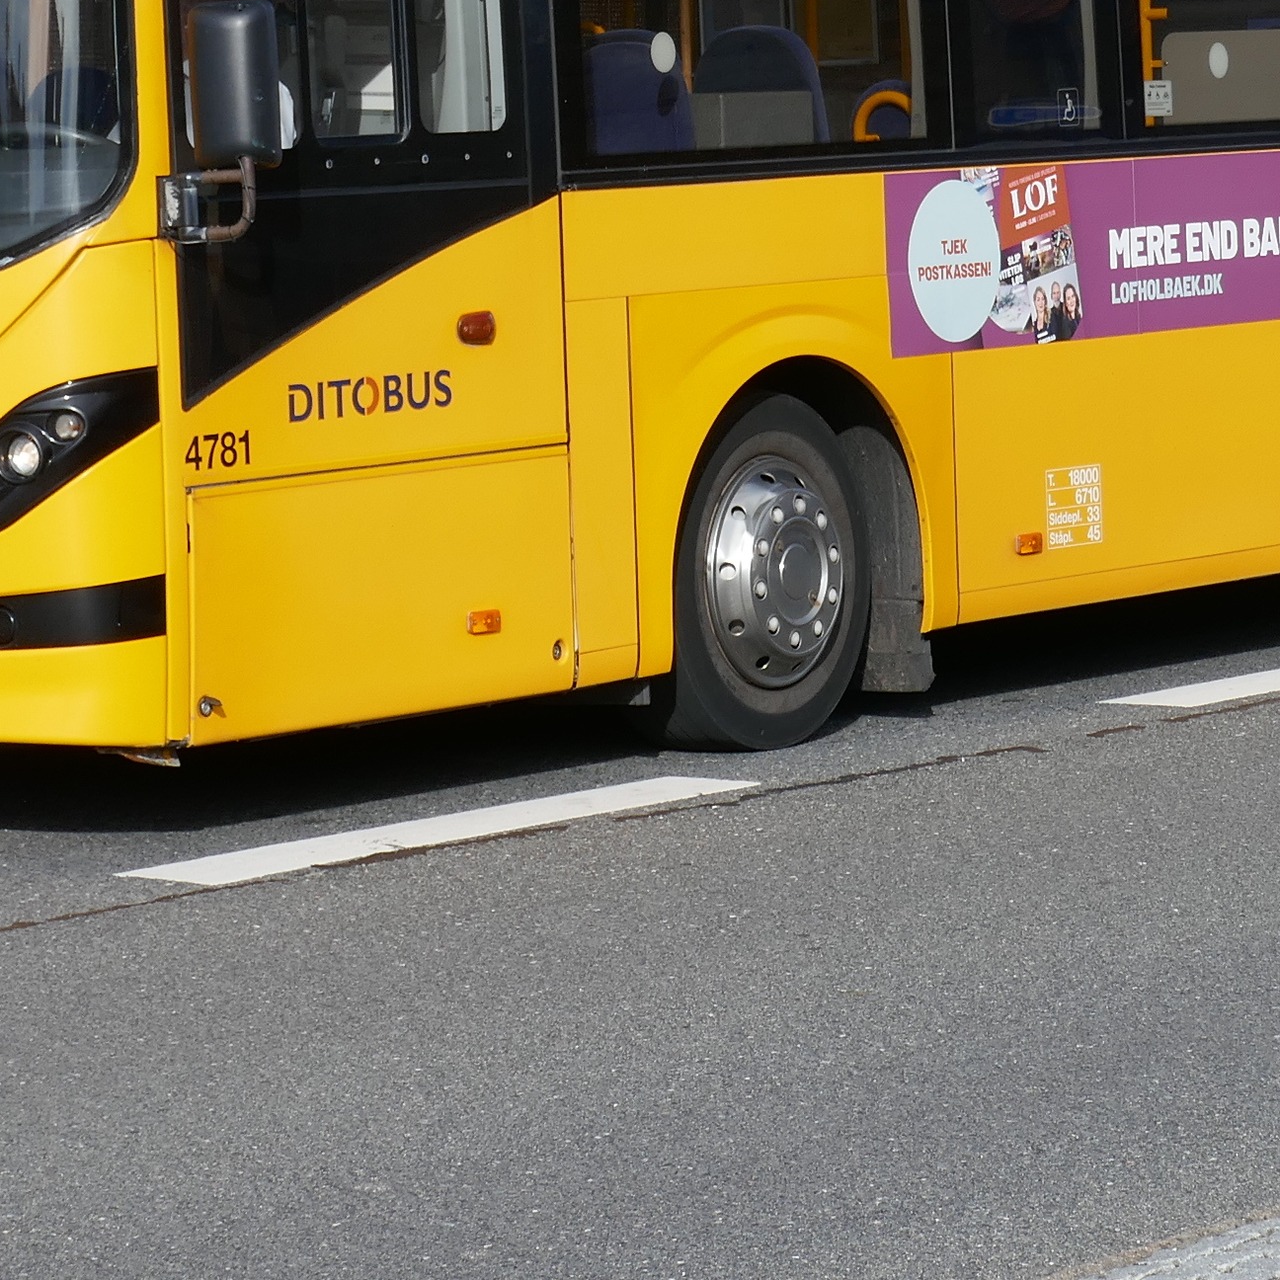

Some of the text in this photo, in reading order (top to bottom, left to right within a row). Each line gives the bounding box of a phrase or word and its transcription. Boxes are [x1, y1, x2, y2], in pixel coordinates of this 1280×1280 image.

[1010, 174, 1058, 219] LOF
[940, 239, 968, 255] TJEK
[1108, 223, 1181, 270] MERE
[1185, 220, 1239, 263] END
[917, 261, 992, 282] POSTKASSEN!
[1110, 273, 1224, 305] LOFHOLBAEK.DK
[287, 369, 453, 423] DITOBUS
[184, 429, 252, 471] 4781
[1048, 467, 1099, 486] T. 18000
[1048, 486, 1100, 506] L. 6710
[1049, 505, 1100, 526] Siddepl. 33
[1049, 525, 1100, 547] Ståpl. 45
